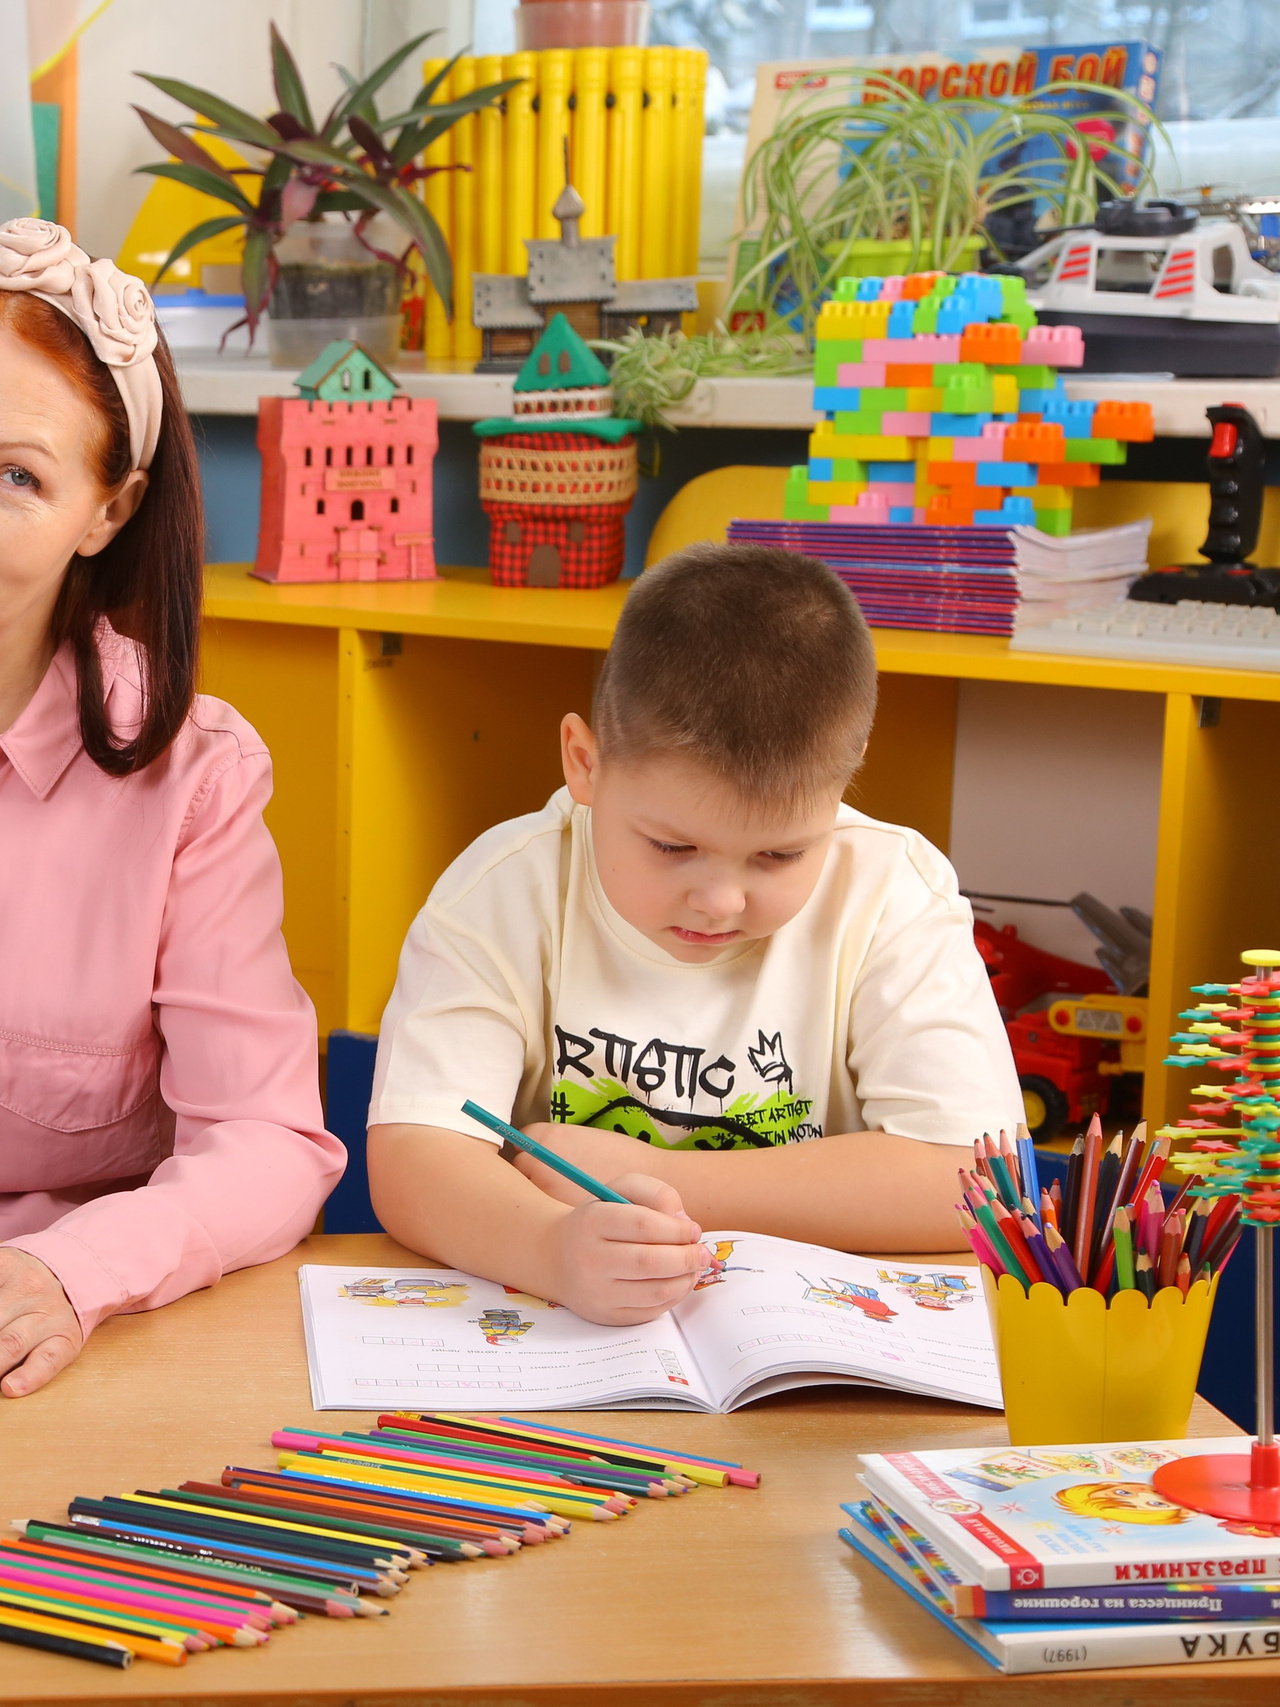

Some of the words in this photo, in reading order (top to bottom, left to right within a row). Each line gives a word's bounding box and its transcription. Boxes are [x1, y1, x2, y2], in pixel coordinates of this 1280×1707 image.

[1049, 46, 1129, 95] БОЙ
[553, 1024, 737, 1100] RTISTIC
[1078, 1462, 1099, 1470] 8
[967, 1518, 1018, 1554] ШКОЛЬНАЯ
[1012, 1595, 1100, 1610] горошине
[1103, 1598, 1124, 1609] на
[1127, 1596, 1223, 1612] Принцесса
[1042, 1646, 1088, 1664] (1997)
